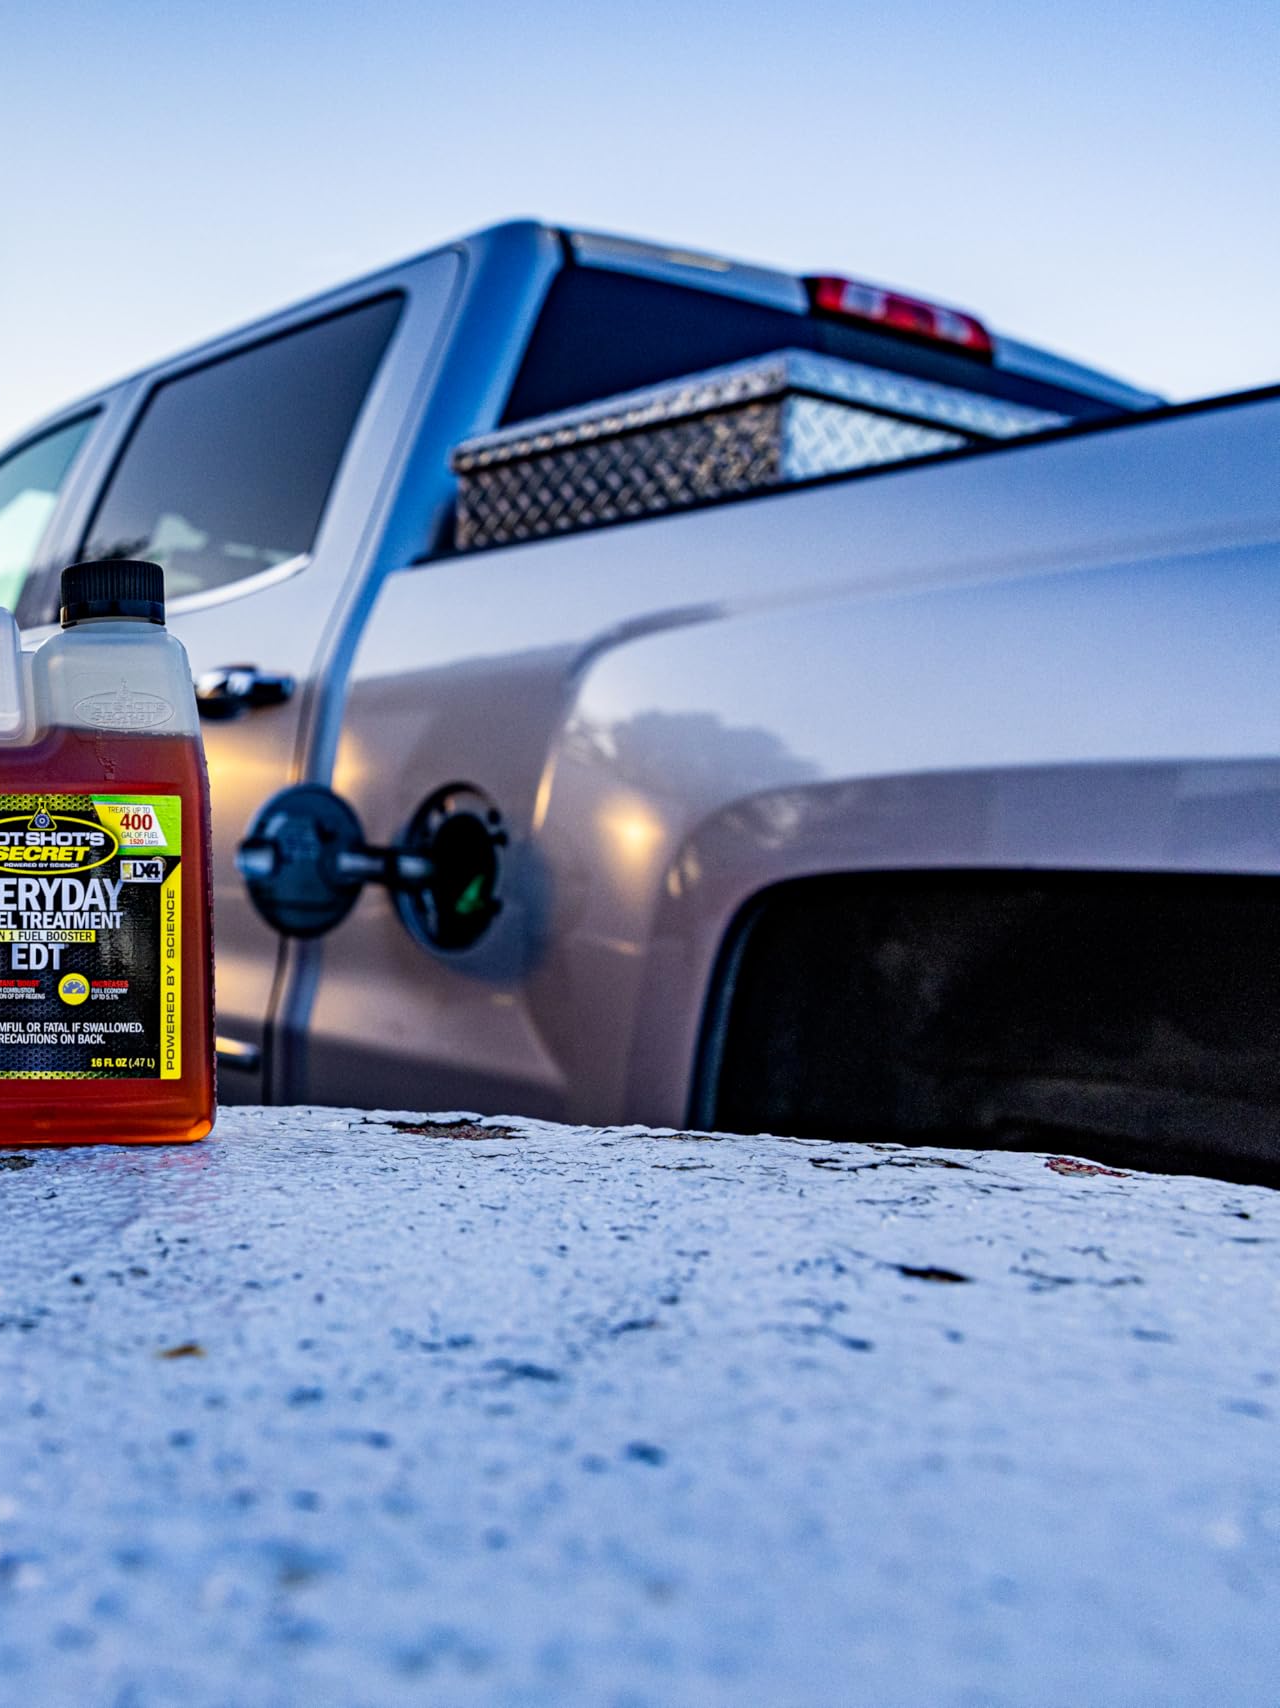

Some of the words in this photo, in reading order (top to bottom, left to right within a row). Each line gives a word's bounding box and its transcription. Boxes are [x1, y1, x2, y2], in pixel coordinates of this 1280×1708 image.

[108, 806, 131, 814] TREATS
[120, 813, 153, 830] 400
[25, 831, 105, 846] SHOT'S
[121, 831, 134, 839] GAL
[135, 831, 143, 839] OF
[132, 862, 161, 878] LX4
[19, 911, 124, 929] TREATMENT
[166, 887, 176, 959] SCIENCE
[9, 931, 15, 941] 1
[18, 931, 44, 941] FUEL
[46, 931, 93, 942] BOOSTER
[11, 943, 66, 971] EDT
[166, 964, 176, 986] BY
[26, 1022, 41, 1033] OR
[43, 1022, 70, 1033] FATAL
[72, 1022, 81, 1033] IF
[82, 1022, 145, 1033] SWALLOWED.
[166, 991, 176, 1071] POWERED
[60, 1034, 76, 1044] ON
[78, 1034, 106, 1045] BACK.
[91, 1058, 102, 1067] 16
[115, 1058, 128, 1067] OZ
[128, 1058, 145, 1069] (.47
[146, 1058, 156, 1069] L)
